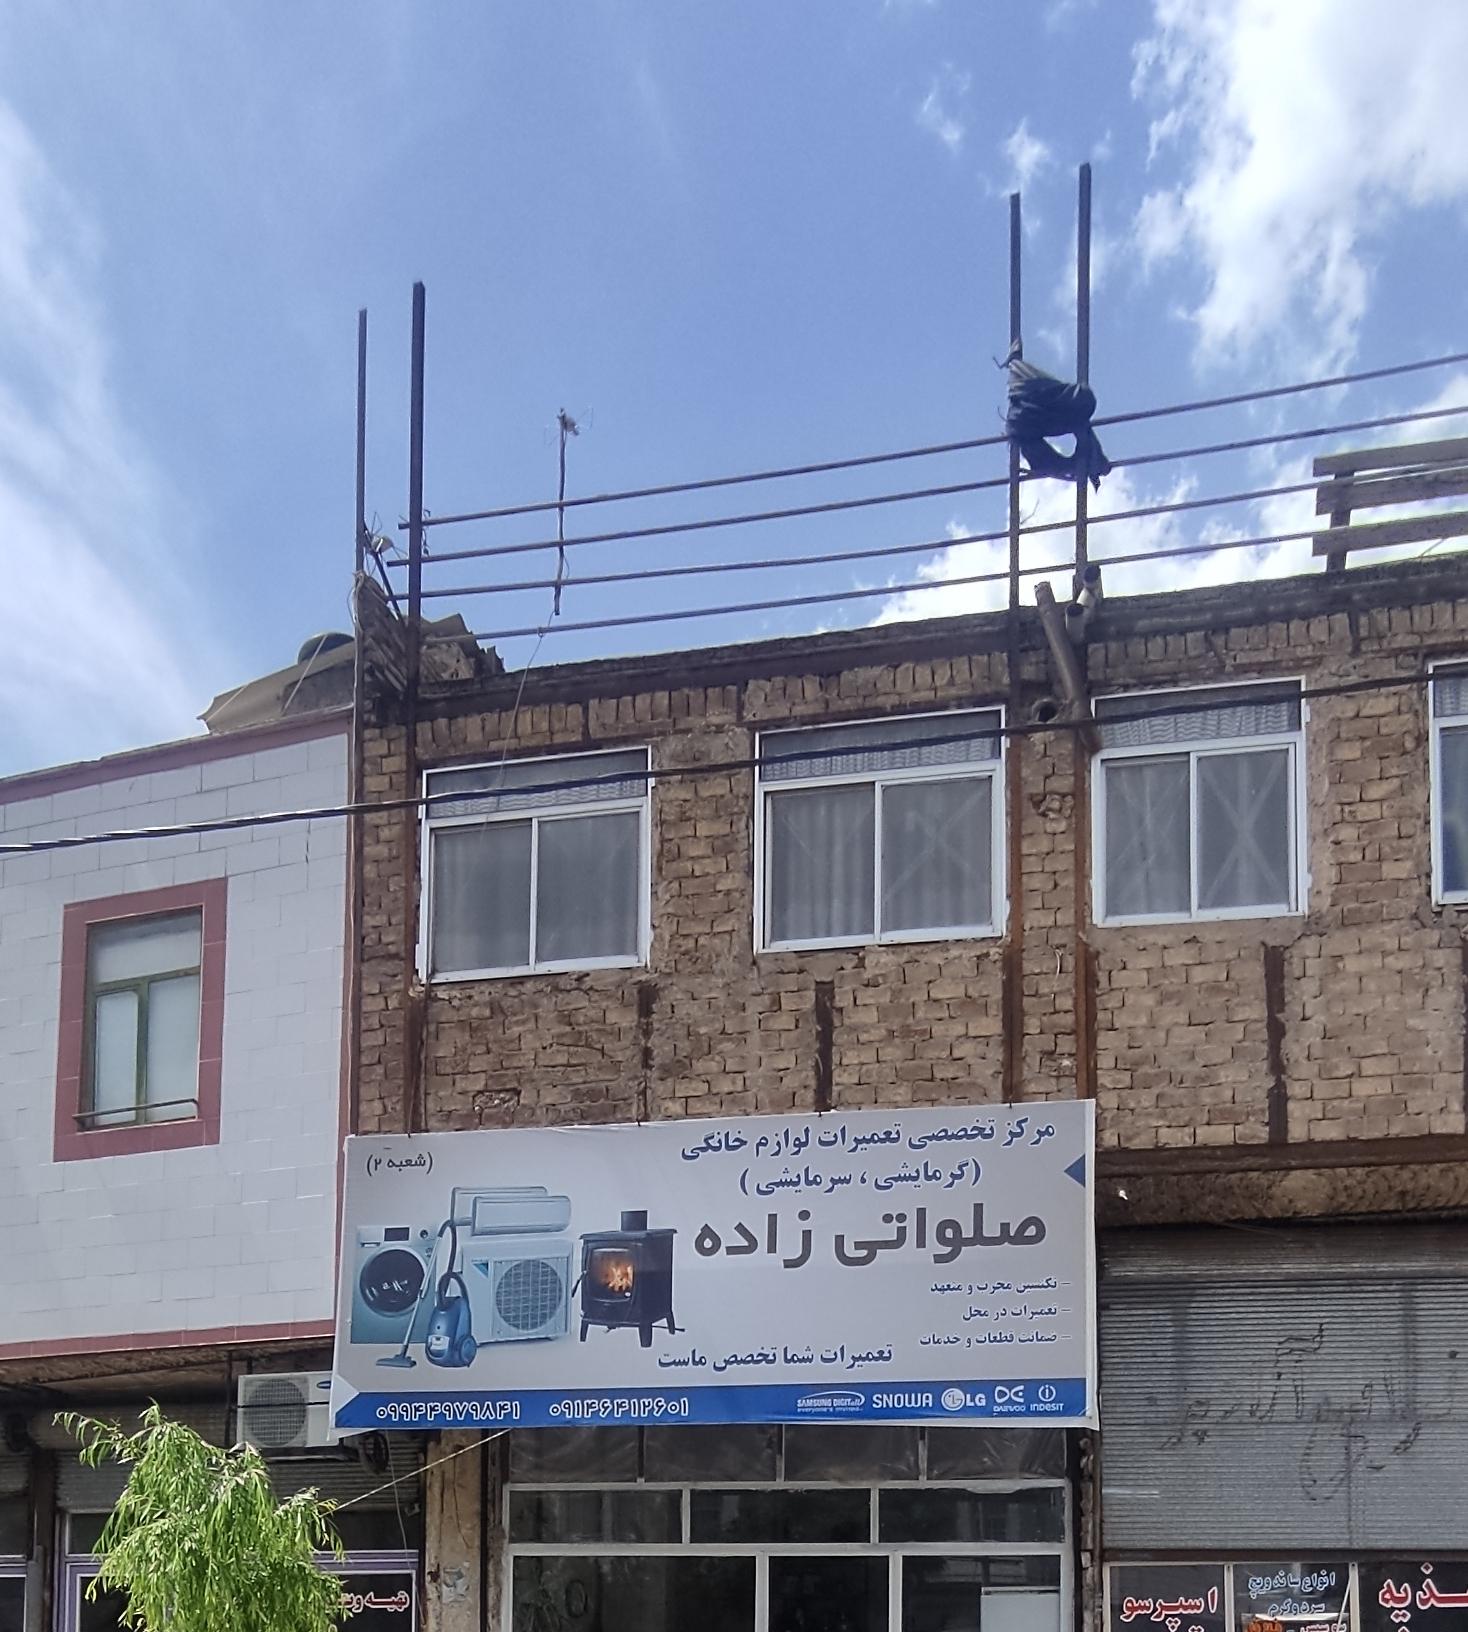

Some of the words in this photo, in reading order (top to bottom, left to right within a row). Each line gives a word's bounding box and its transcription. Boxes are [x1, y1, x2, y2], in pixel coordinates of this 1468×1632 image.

[755, 1126, 810, 1157] لوازم
[817, 1122, 901, 1154] تعمیرات
[907, 1120, 996, 1151] تخصصی
[1003, 1117, 1055, 1147] مرکز
[680, 1130, 748, 1161] خانگی
[694, 1209, 813, 1269] زاده
[834, 1203, 1047, 1267] صلواتی
[966, 1284, 974, 1295] و
[962, 1305, 990, 1322] محل
[993, 1306, 1008, 1321] در
[1010, 1304, 1058, 1321] تعمیرات
[919, 1332, 961, 1346] خدمات
[965, 1336, 973, 1348] و
[975, 1331, 1015, 1345] قطعات
[1018, 1330, 1058, 1344] ضمانت
[658, 1348, 708, 1369] ماست
[713, 1346, 778, 1372] تخصص
[783, 1345, 815, 1365] شما
[819, 1344, 894, 1369] تعمیرات
[375, 1400, 521, 1422] ۰۹۹۴۴۹۷۹۸۴۱
[549, 1397, 690, 1419] ۰۹۱۴۶۴۱۲۶۰۱
[797, 1398, 832, 1408] SAMSUNG
[872, 1392, 933, 1409] SNOWA
[966, 1393, 986, 1407] LG
[1248, 1570, 1301, 1600] ساندویچ
[1301, 1569, 1336, 1593] انواع
[1120, 1586, 1218, 1632] اسپرسو
